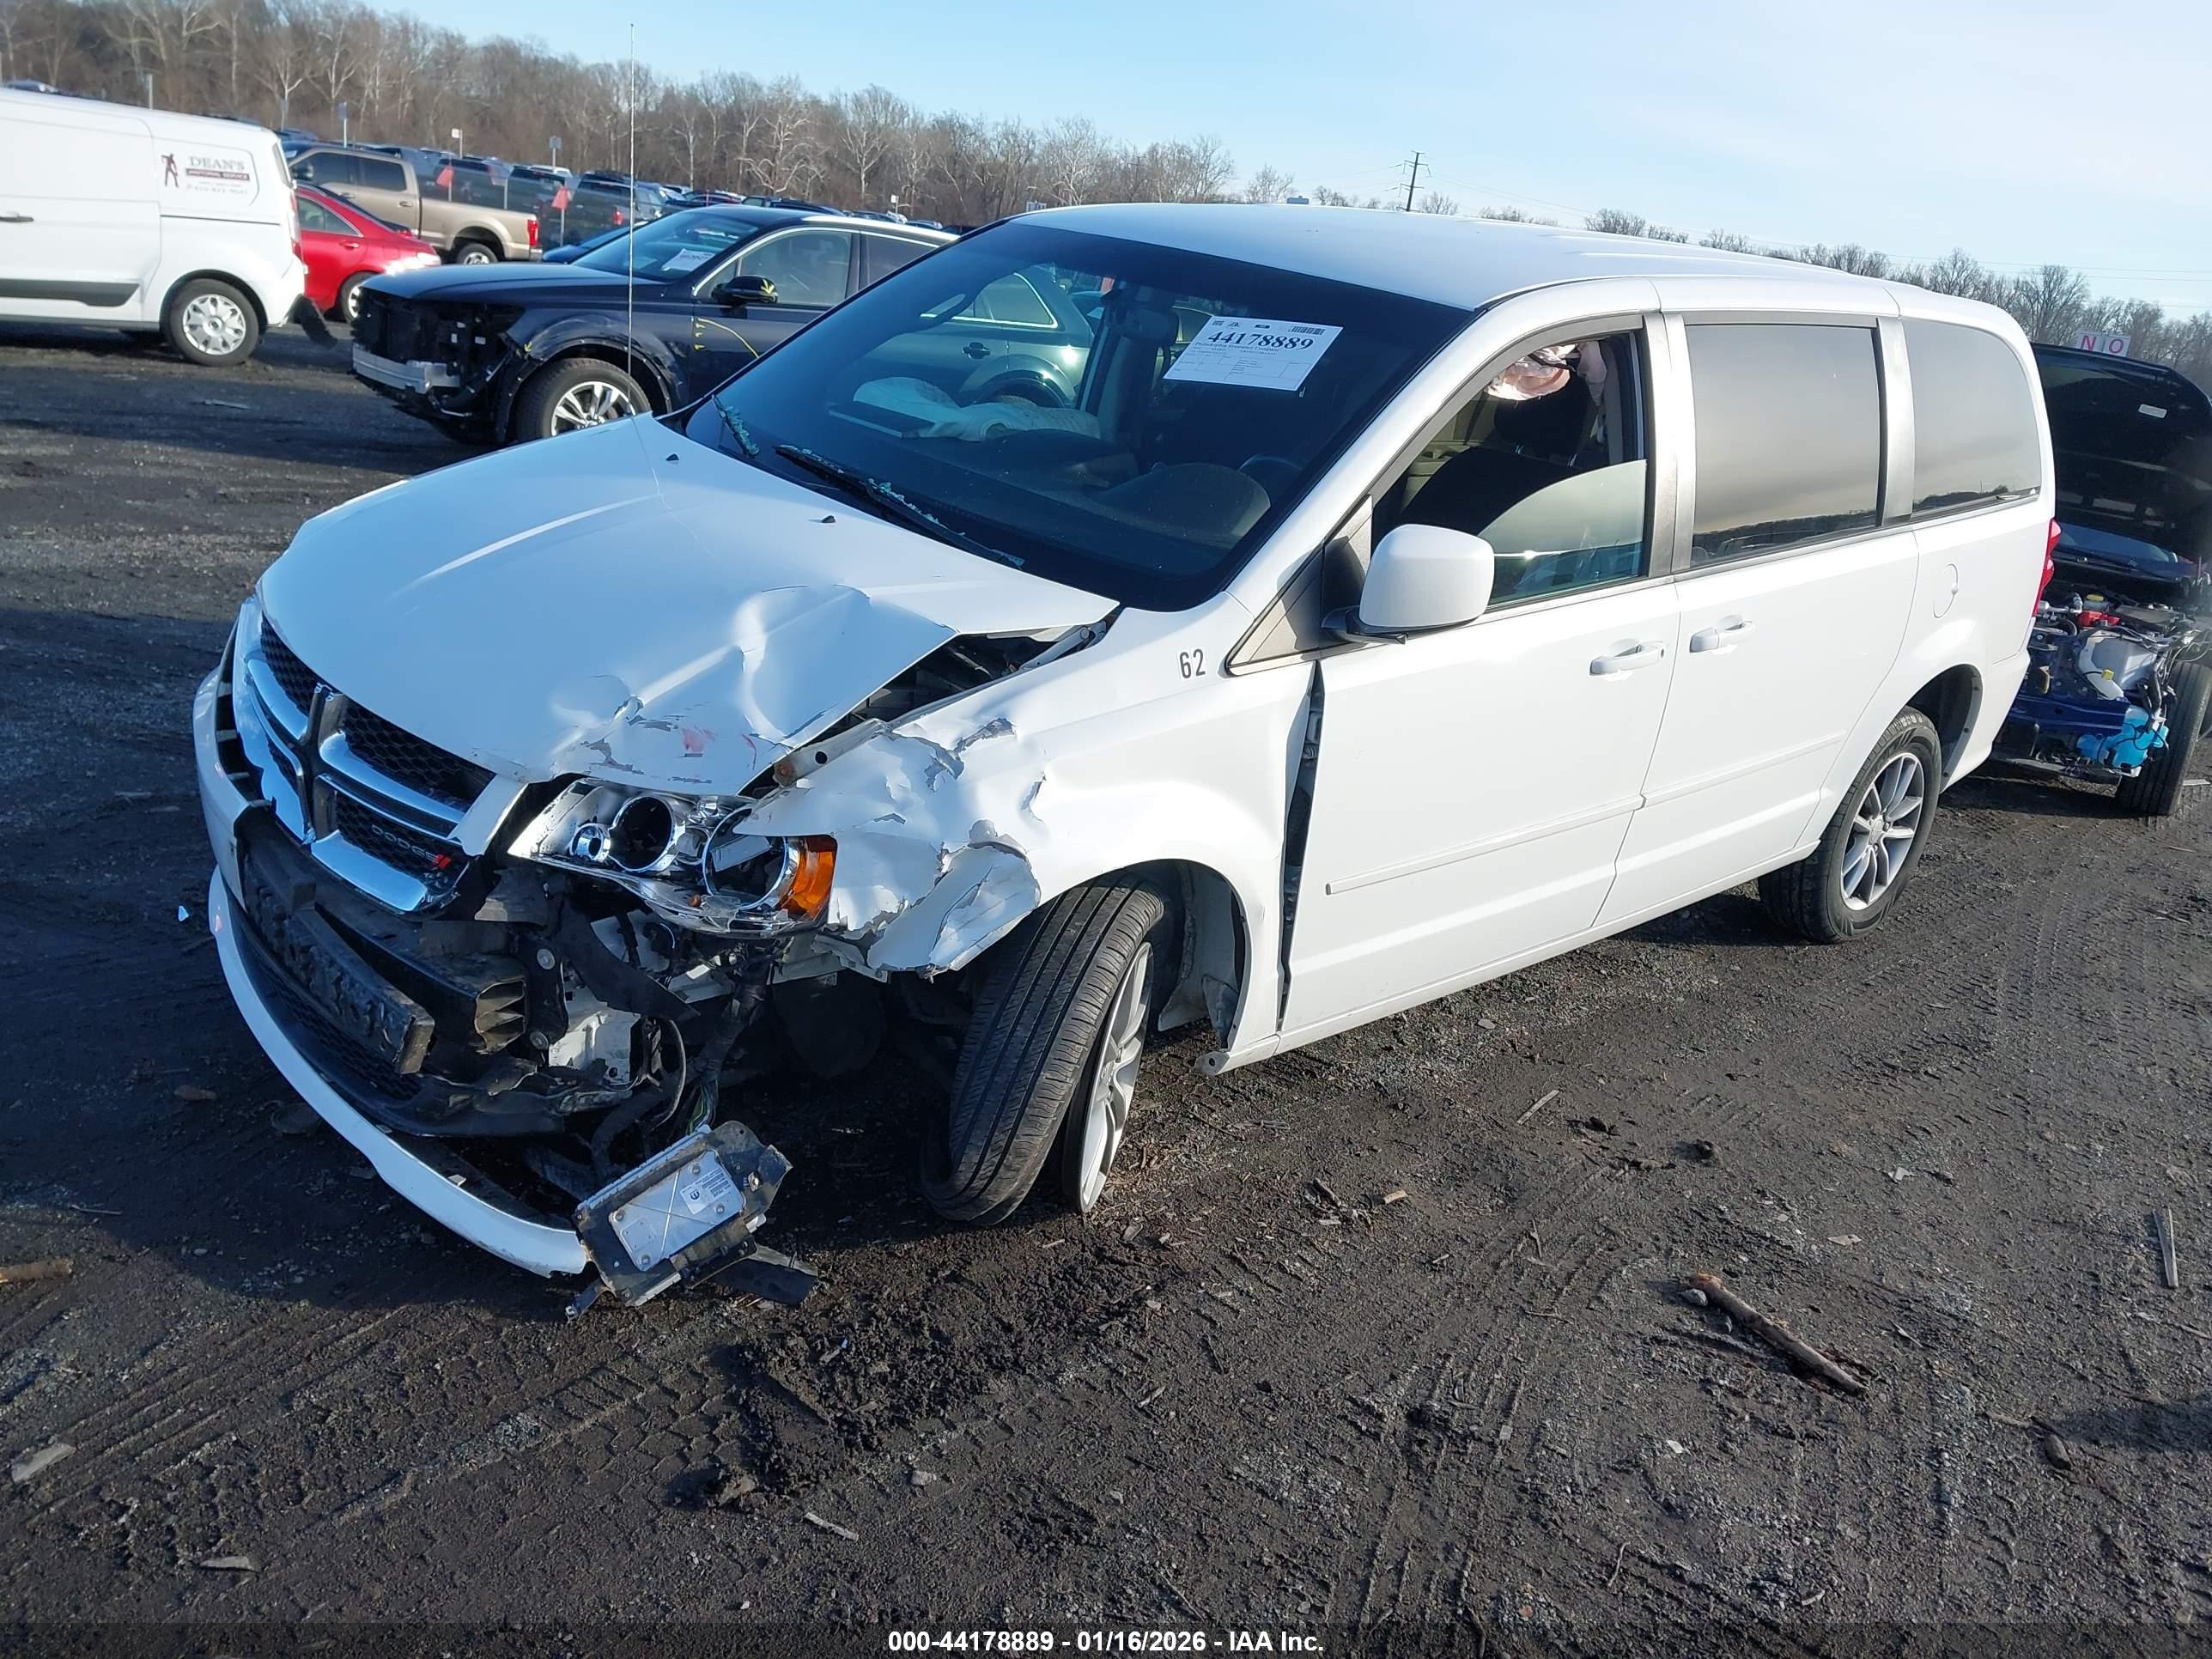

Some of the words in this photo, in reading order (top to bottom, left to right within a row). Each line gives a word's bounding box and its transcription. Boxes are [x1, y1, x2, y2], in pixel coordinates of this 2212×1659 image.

[189, 155, 245, 171] DEAN'S
[1207, 331, 1314, 350] 44178889
[1179, 648, 1206, 679] 62
[371, 824, 440, 864] DODGE
